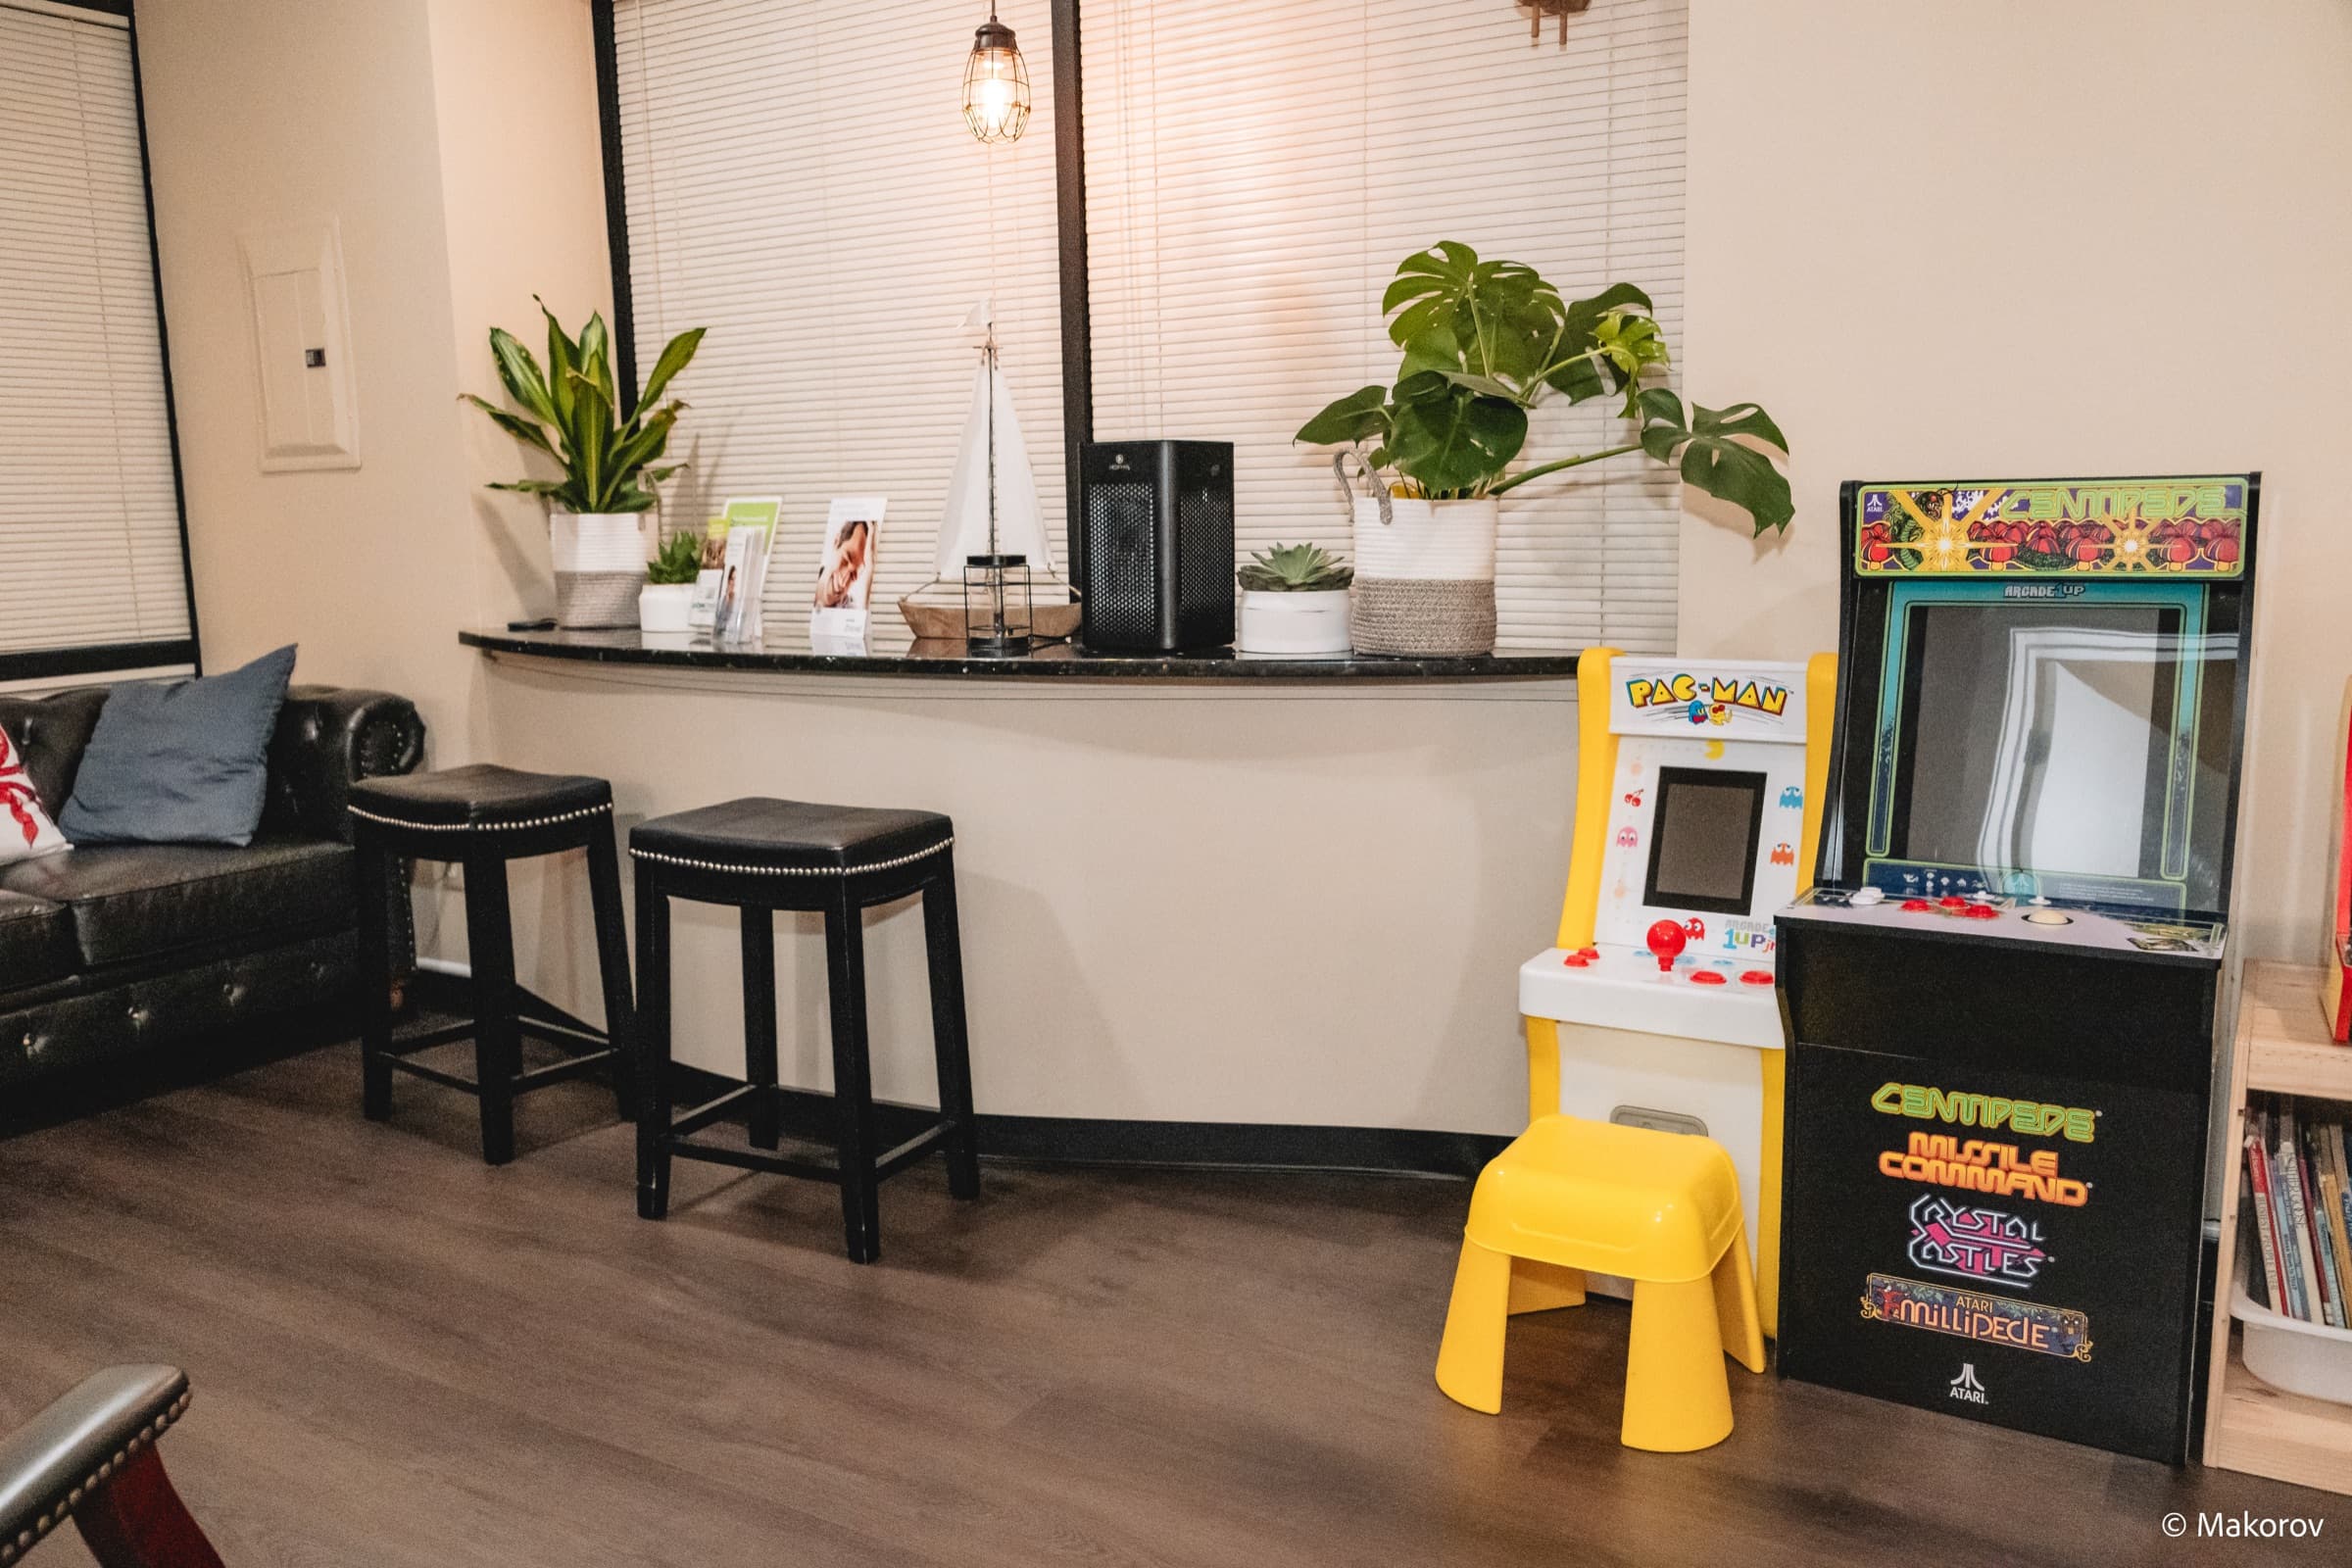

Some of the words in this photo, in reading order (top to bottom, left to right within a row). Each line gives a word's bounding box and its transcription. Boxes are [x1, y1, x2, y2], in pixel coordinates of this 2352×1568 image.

[2000, 486, 2227, 520] CENTIPEDE
[1626, 673, 1788, 716] PAC-MAN
[1871, 1082, 2095, 1143] CENTIPEDE
[1908, 1131, 2059, 1176] MISSILE
[1879, 1151, 2088, 1207] COMMAND
[1910, 1194, 2045, 1249] CRYSTAL
[1907, 1234, 2043, 1288] CASTLES
[1956, 1296, 1993, 1313] ATARI
[1949, 1387, 1985, 1404] ATARI
